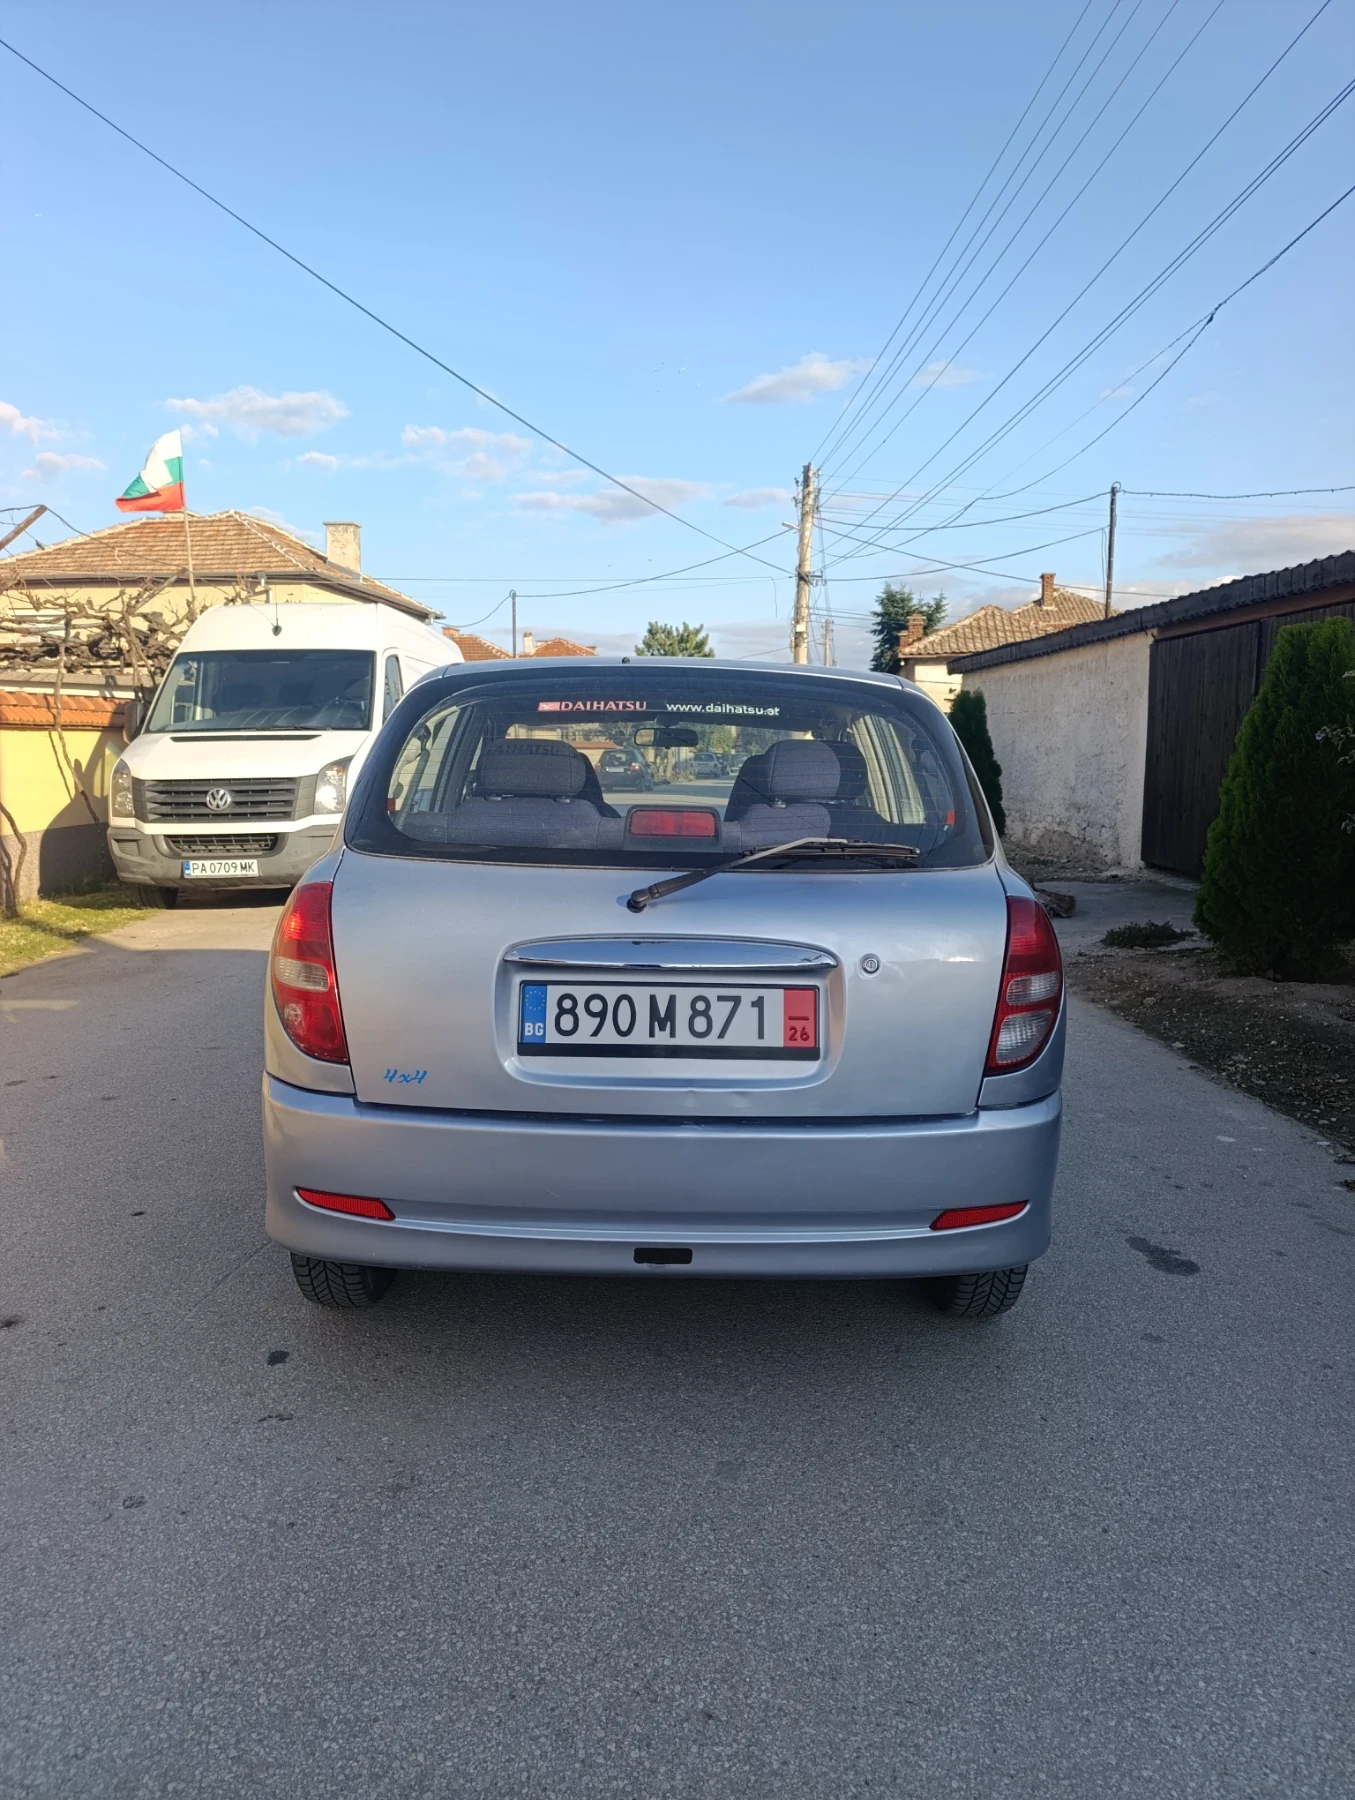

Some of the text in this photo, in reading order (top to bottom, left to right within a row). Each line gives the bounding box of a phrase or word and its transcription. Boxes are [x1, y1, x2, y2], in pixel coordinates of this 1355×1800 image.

[561, 701, 647, 711] DAIHATSU
[666, 703, 780, 716] www.daihatsu.at
[206, 788, 231, 810] VW
[191, 862, 208, 874] PA
[209, 861, 238, 874] 0709
[240, 861, 255, 873] MK
[554, 993, 765, 1040] 890 M 871
[525, 1022, 544, 1036] BG
[788, 1025, 810, 1042] 26
[383, 1068, 428, 1084] 4x4
